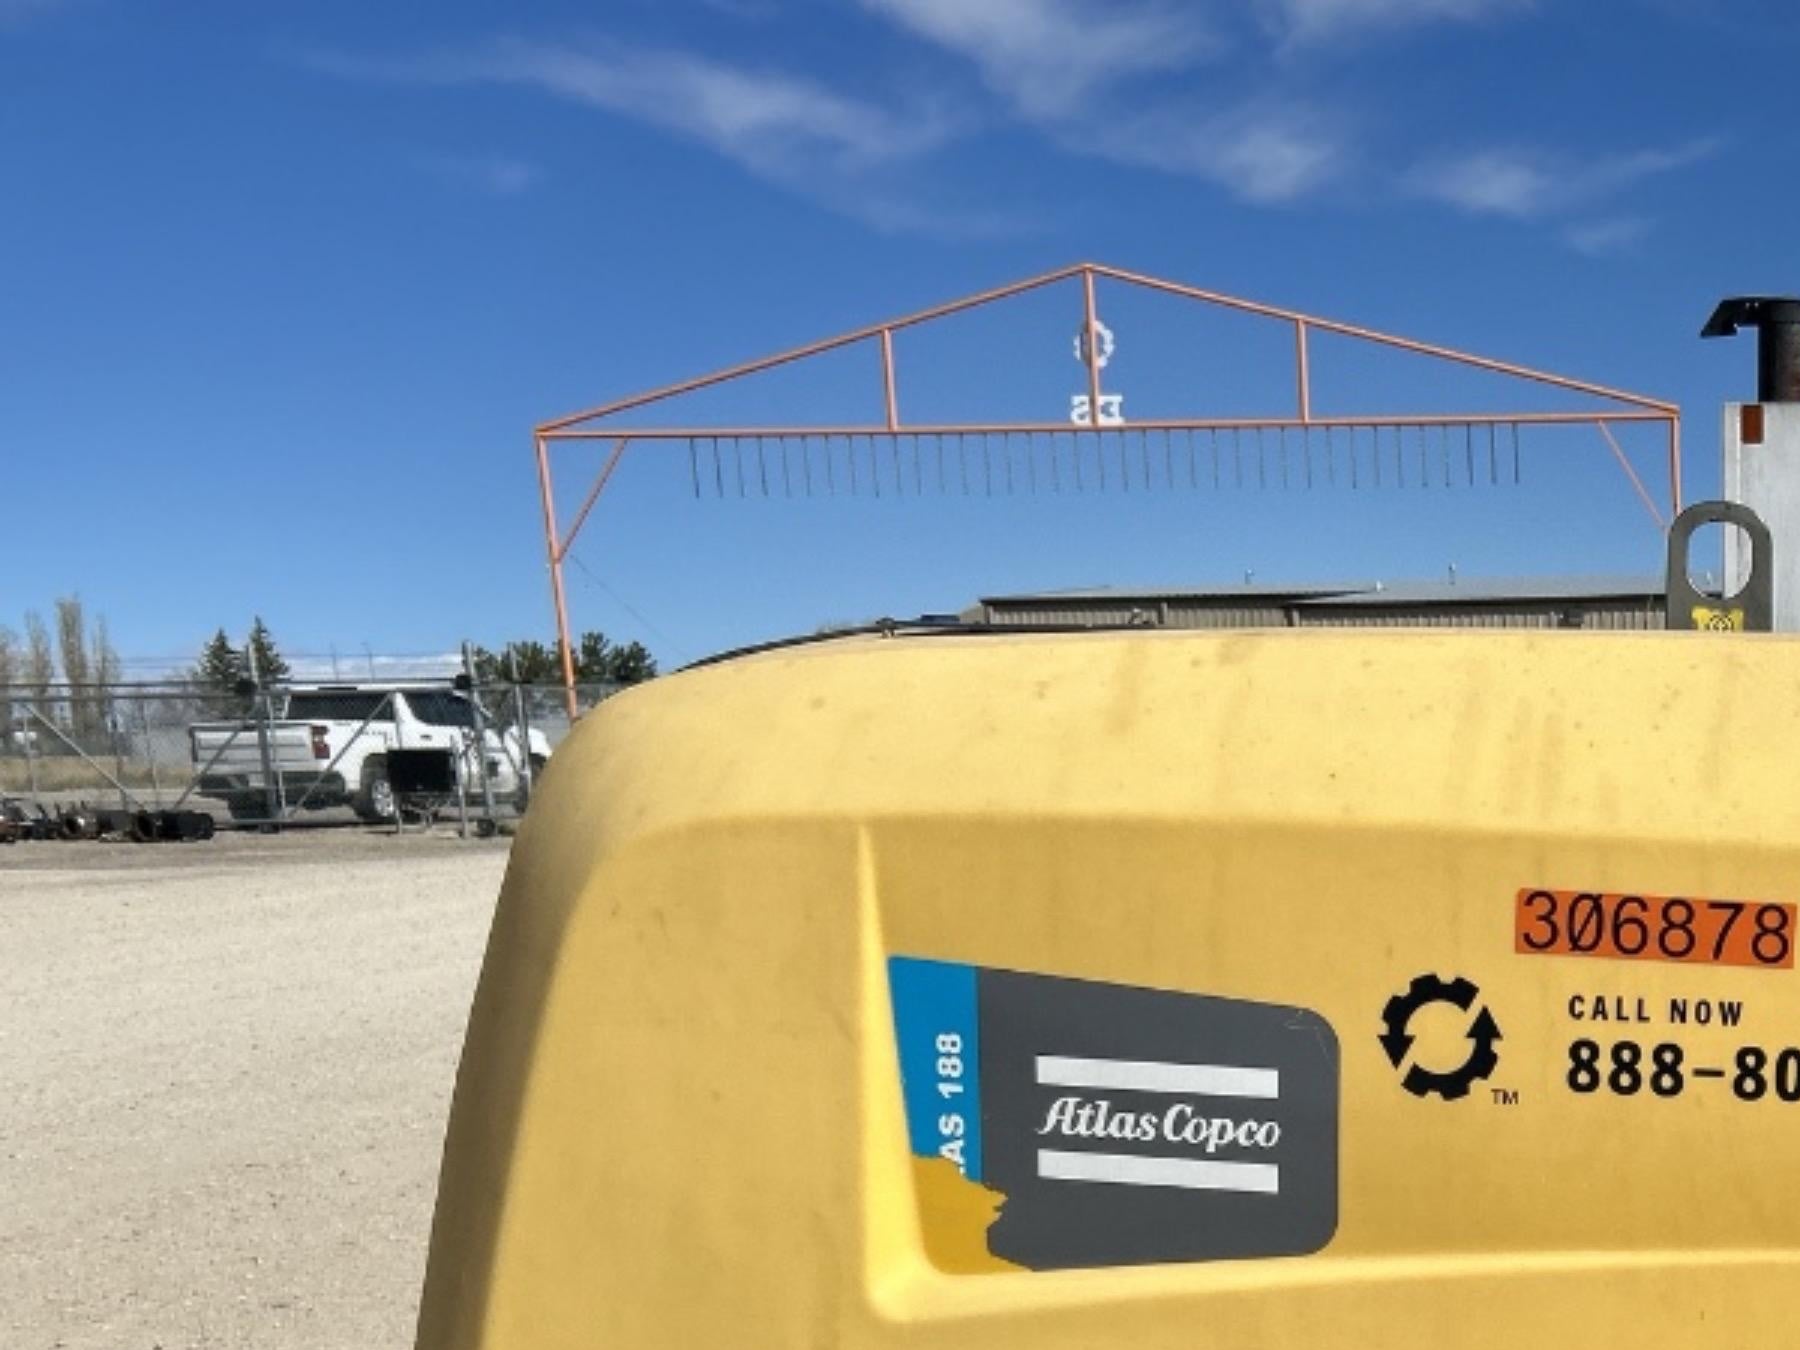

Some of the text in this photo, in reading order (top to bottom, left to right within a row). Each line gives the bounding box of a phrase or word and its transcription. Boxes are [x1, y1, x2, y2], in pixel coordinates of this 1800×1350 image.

[1522, 890, 1792, 964] 306878
[1568, 995, 1743, 1027] CALL NOW
[935, 1032, 964, 1098] 188
[1035, 1097, 1281, 1153] Atlas Copco
